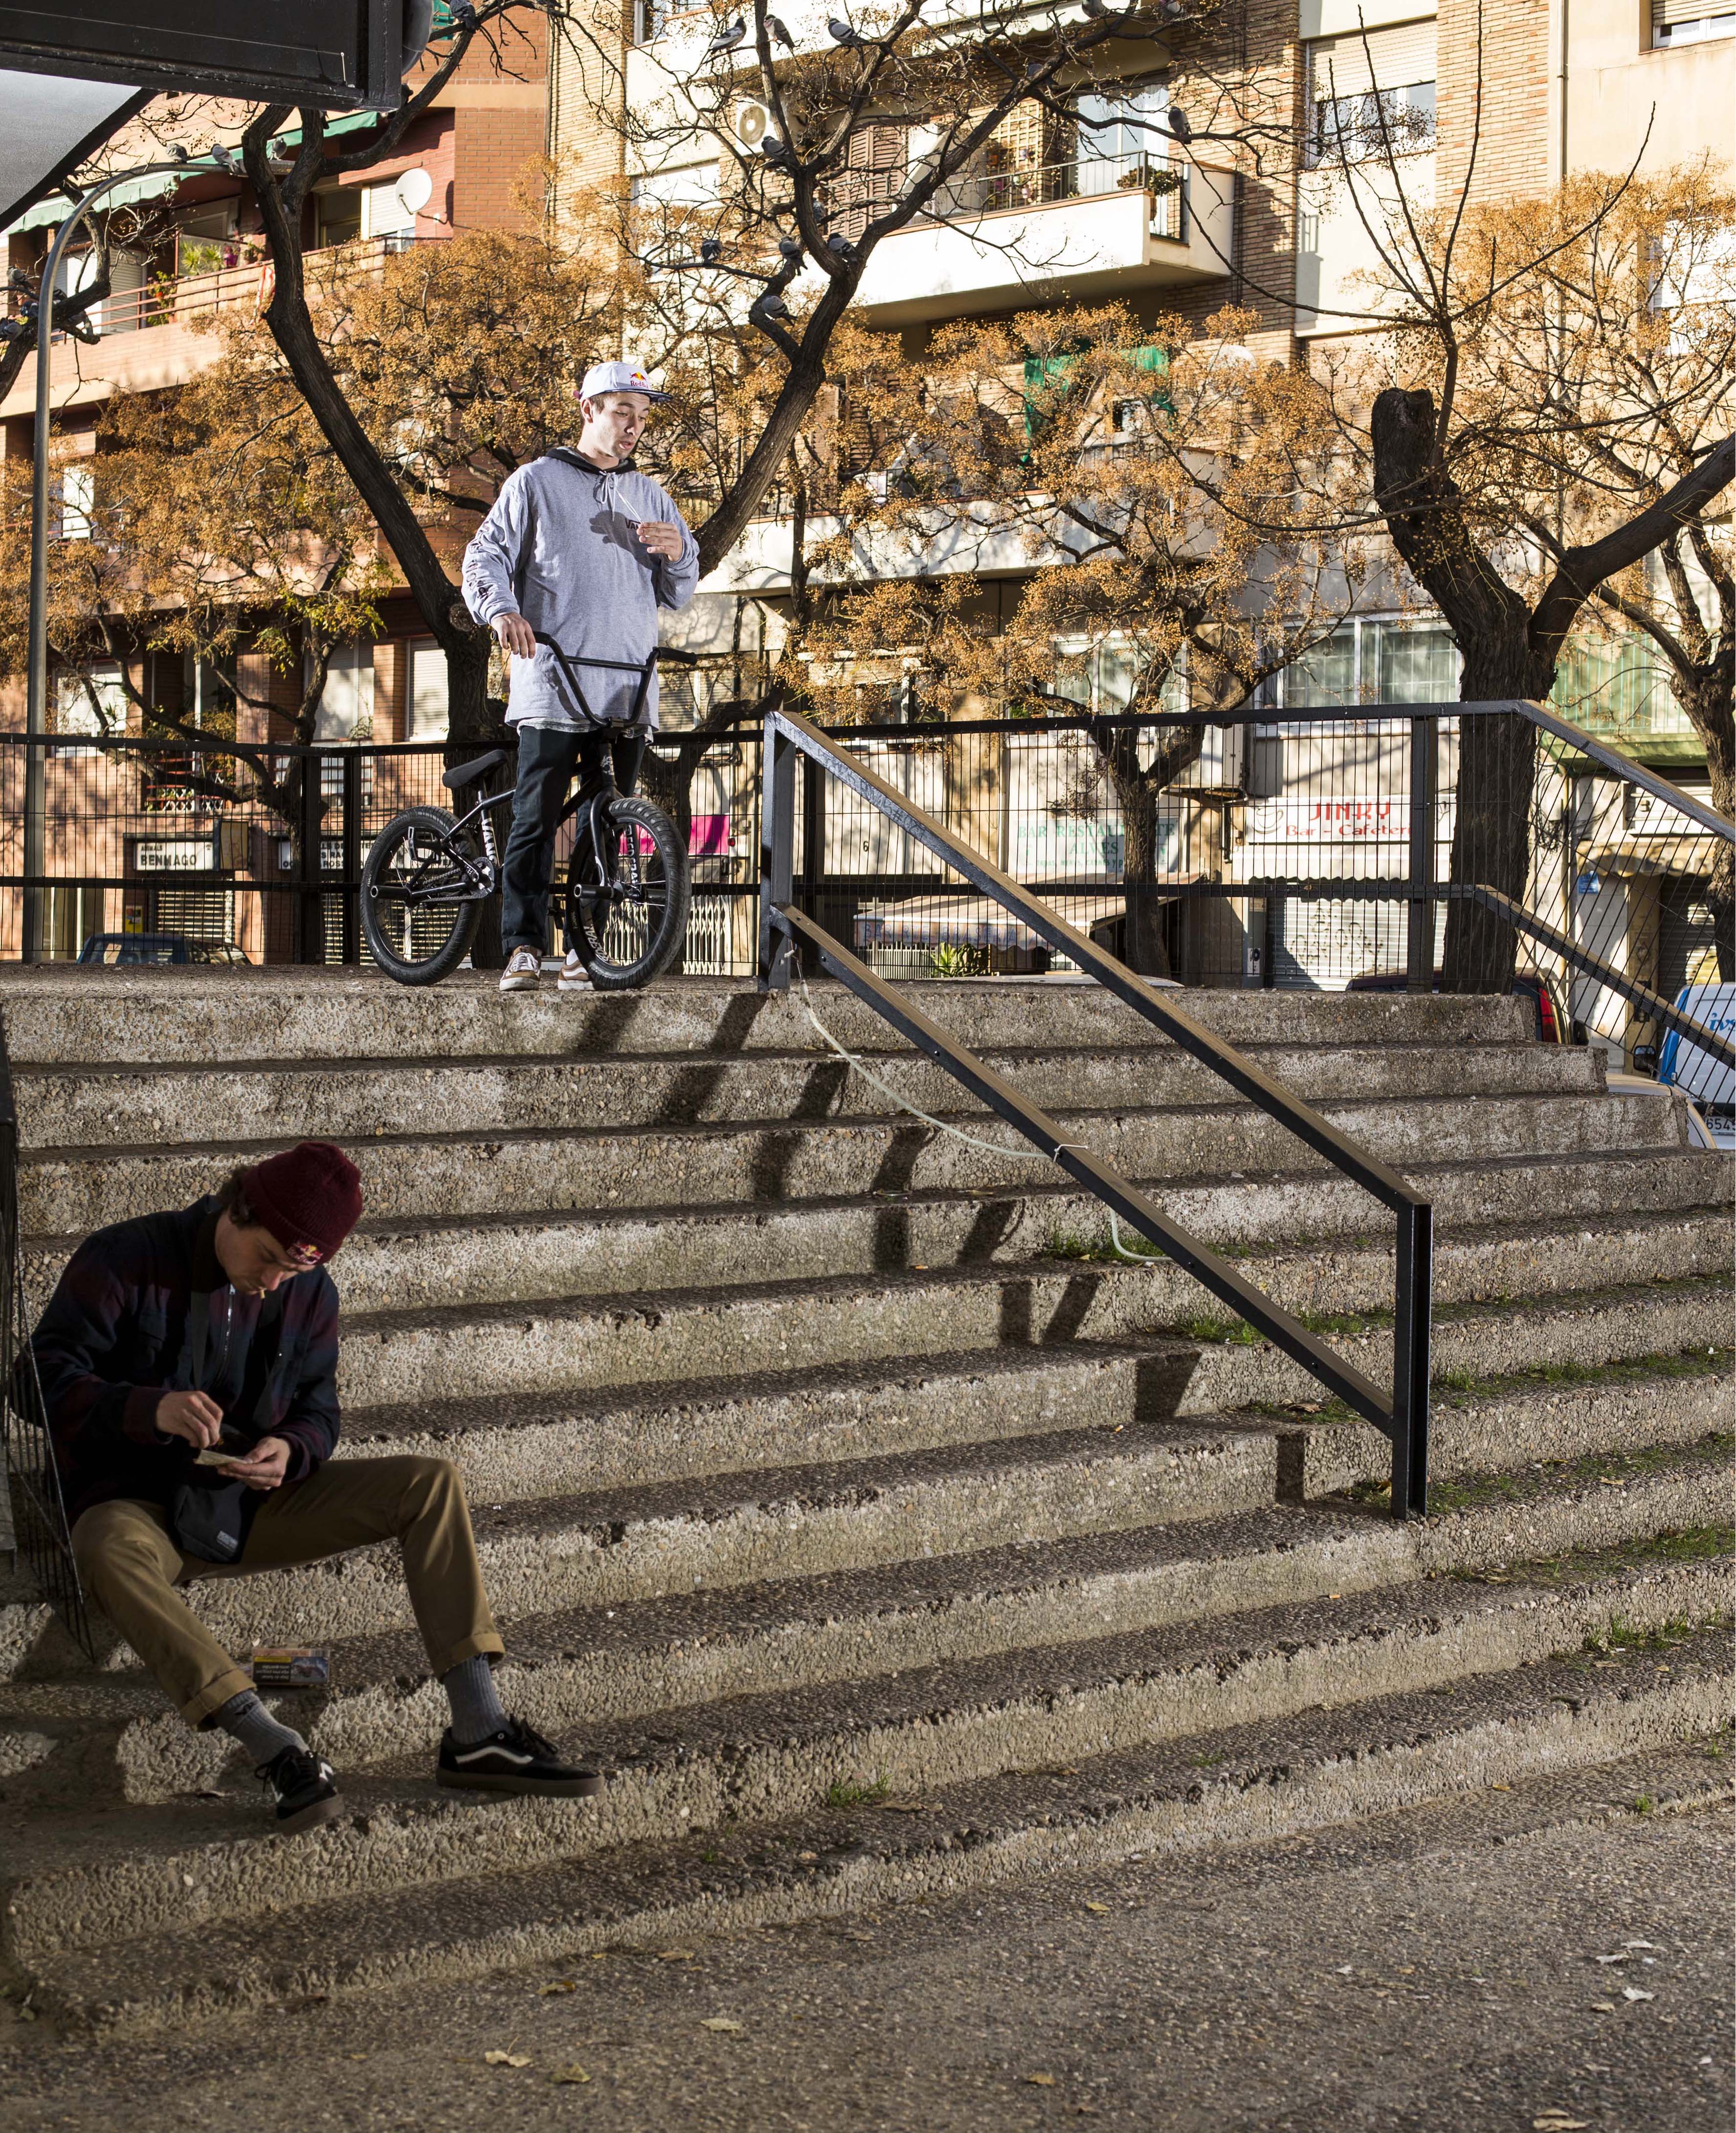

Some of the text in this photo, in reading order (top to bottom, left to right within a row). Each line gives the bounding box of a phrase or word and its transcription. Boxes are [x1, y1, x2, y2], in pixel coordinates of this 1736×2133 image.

[1310, 802, 1390, 821] JINKY
[1019, 826, 1047, 838] BAR
[1287, 825, 1316, 836] Bar
[863, 841, 868, 852] 6
[1069, 842, 1118, 854] ALVES
[140, 854, 197, 866] BENMAGO
